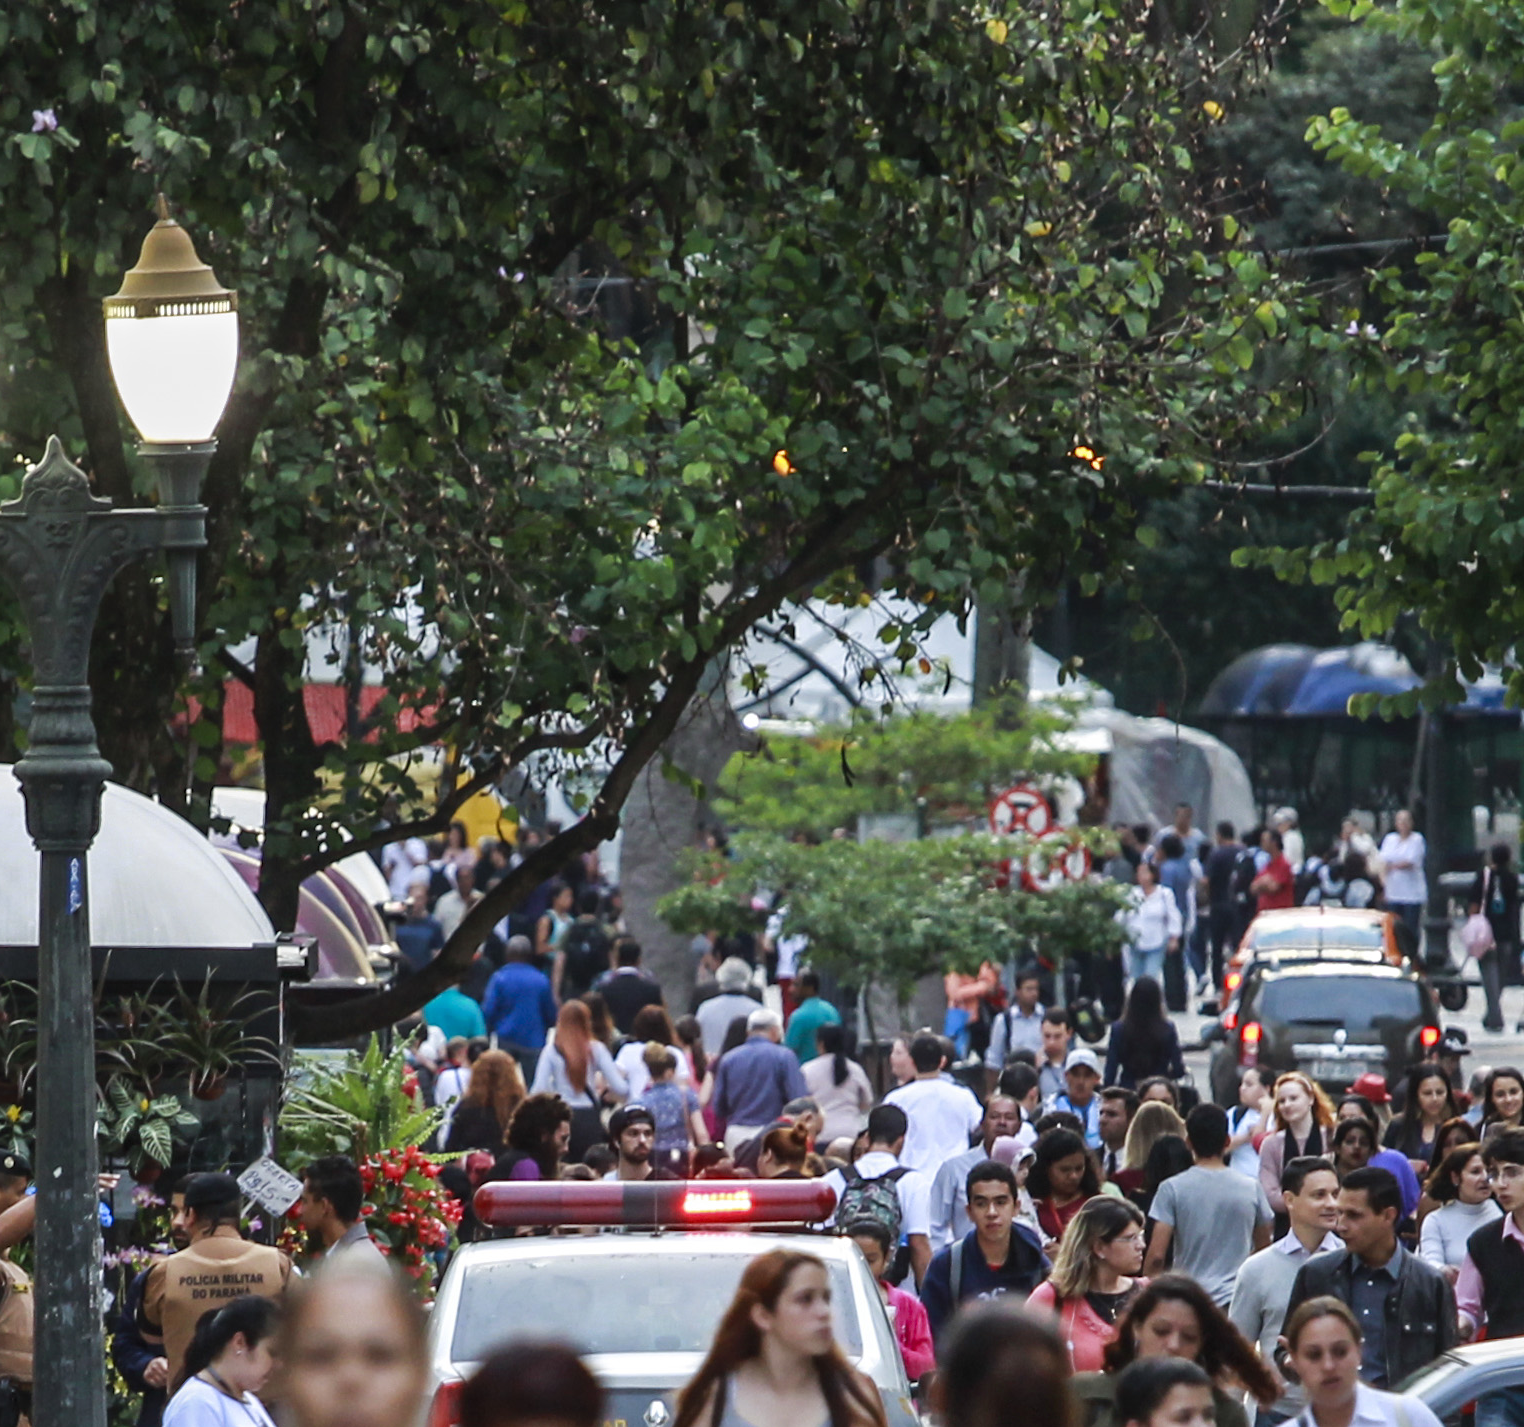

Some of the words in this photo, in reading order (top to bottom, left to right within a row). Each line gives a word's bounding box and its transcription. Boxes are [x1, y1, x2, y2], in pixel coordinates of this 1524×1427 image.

[179, 1273, 220, 1287] POLÍCIA
[222, 1273, 264, 1286] MILITAR
[192, 1288, 207, 1300] DO
